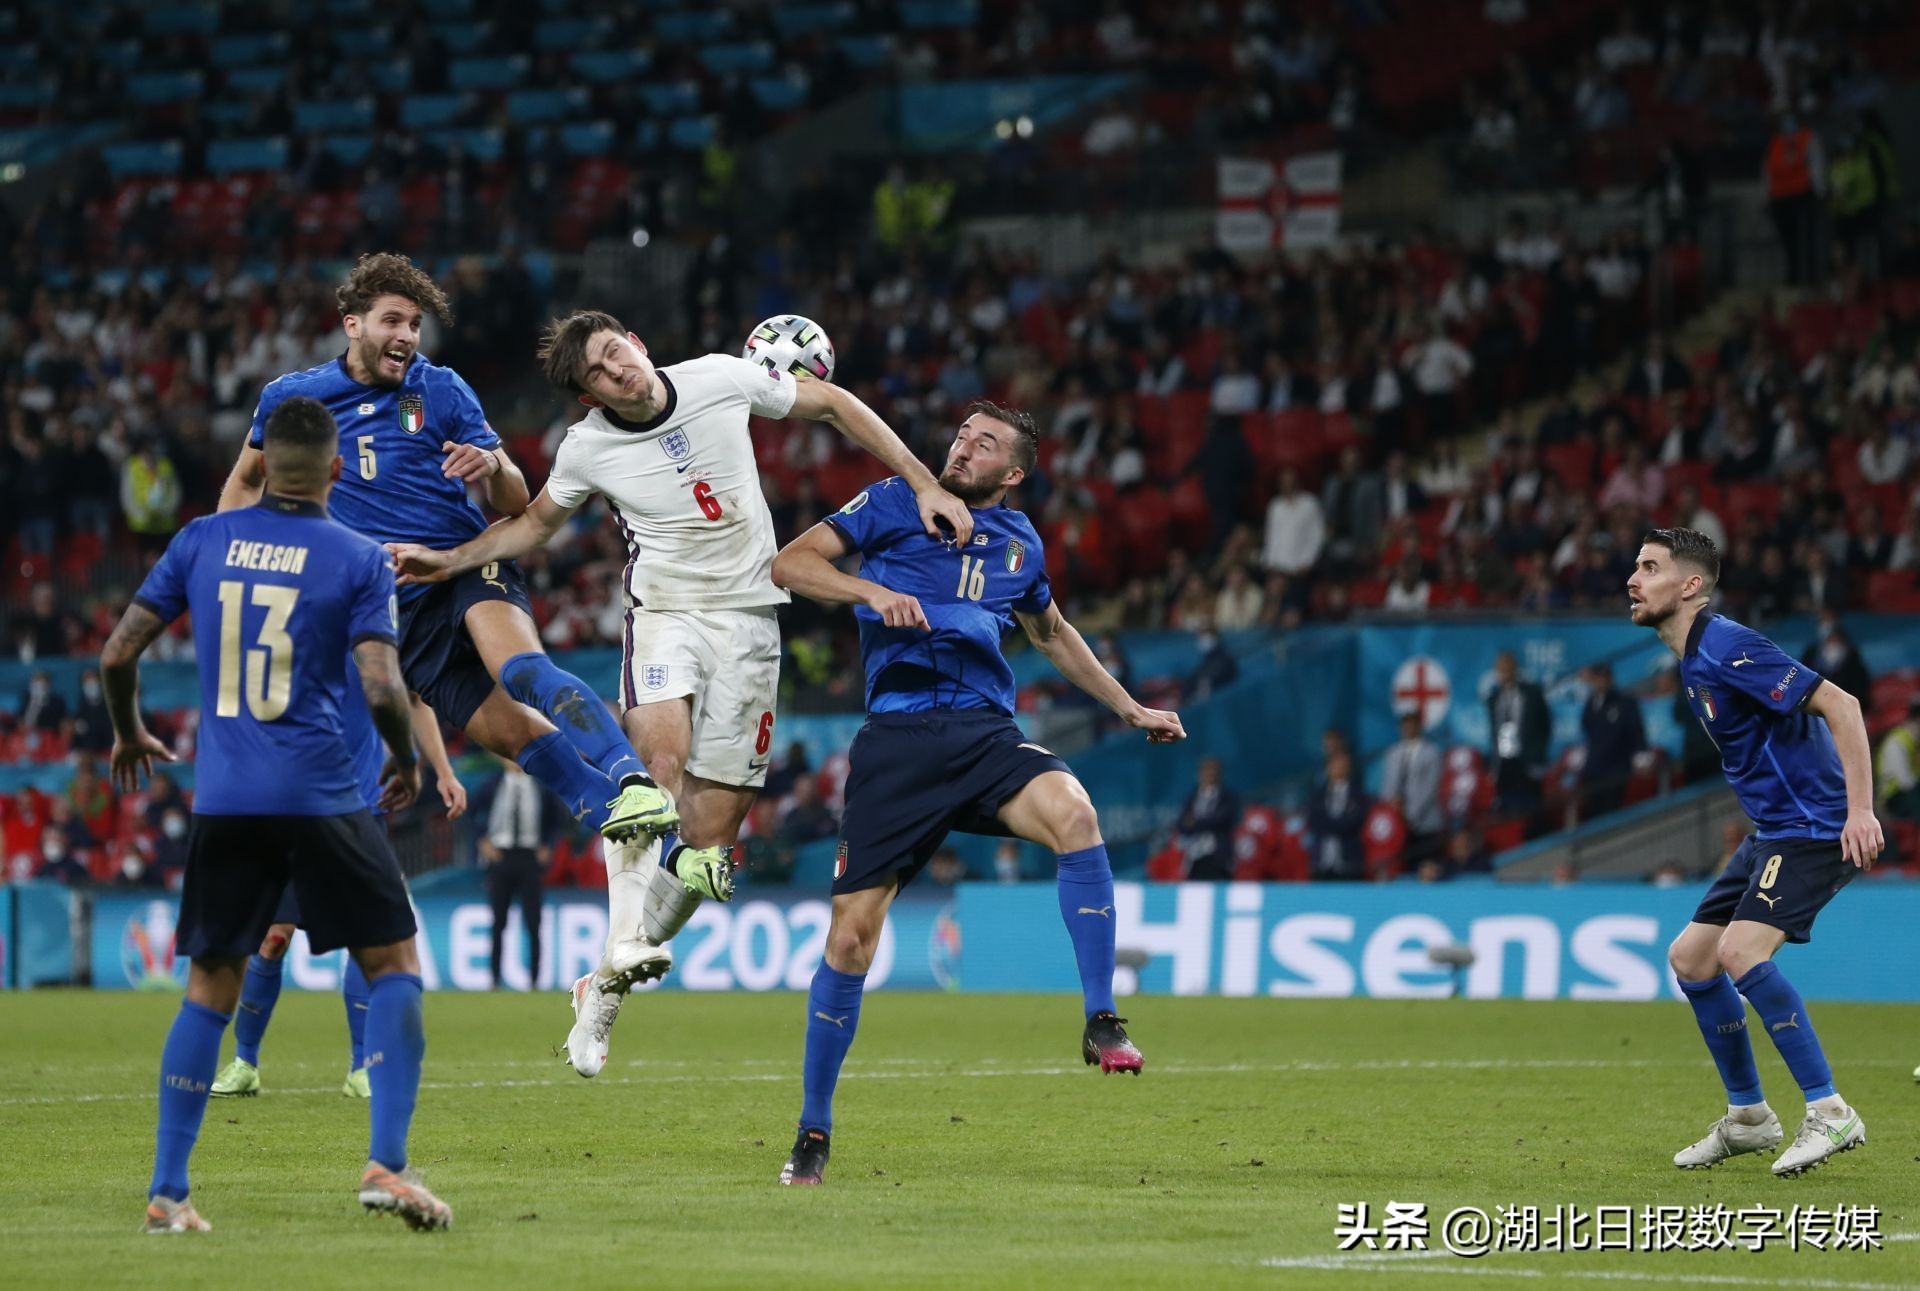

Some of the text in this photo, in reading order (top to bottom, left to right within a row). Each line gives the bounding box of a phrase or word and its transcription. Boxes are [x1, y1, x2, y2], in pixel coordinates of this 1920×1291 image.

[357, 435, 377, 481] 5
[693, 482, 722, 521] 6
[225, 539, 308, 574] EMERSON
[956, 554, 986, 601] 16
[216, 580, 300, 722] 13
[1778, 666, 1798, 692] RESPECT
[755, 710, 774, 755] 6
[1759, 854, 1783, 890] 8
[448, 903, 667, 991] EUR
[1113, 881, 1691, 1001] Hisens
